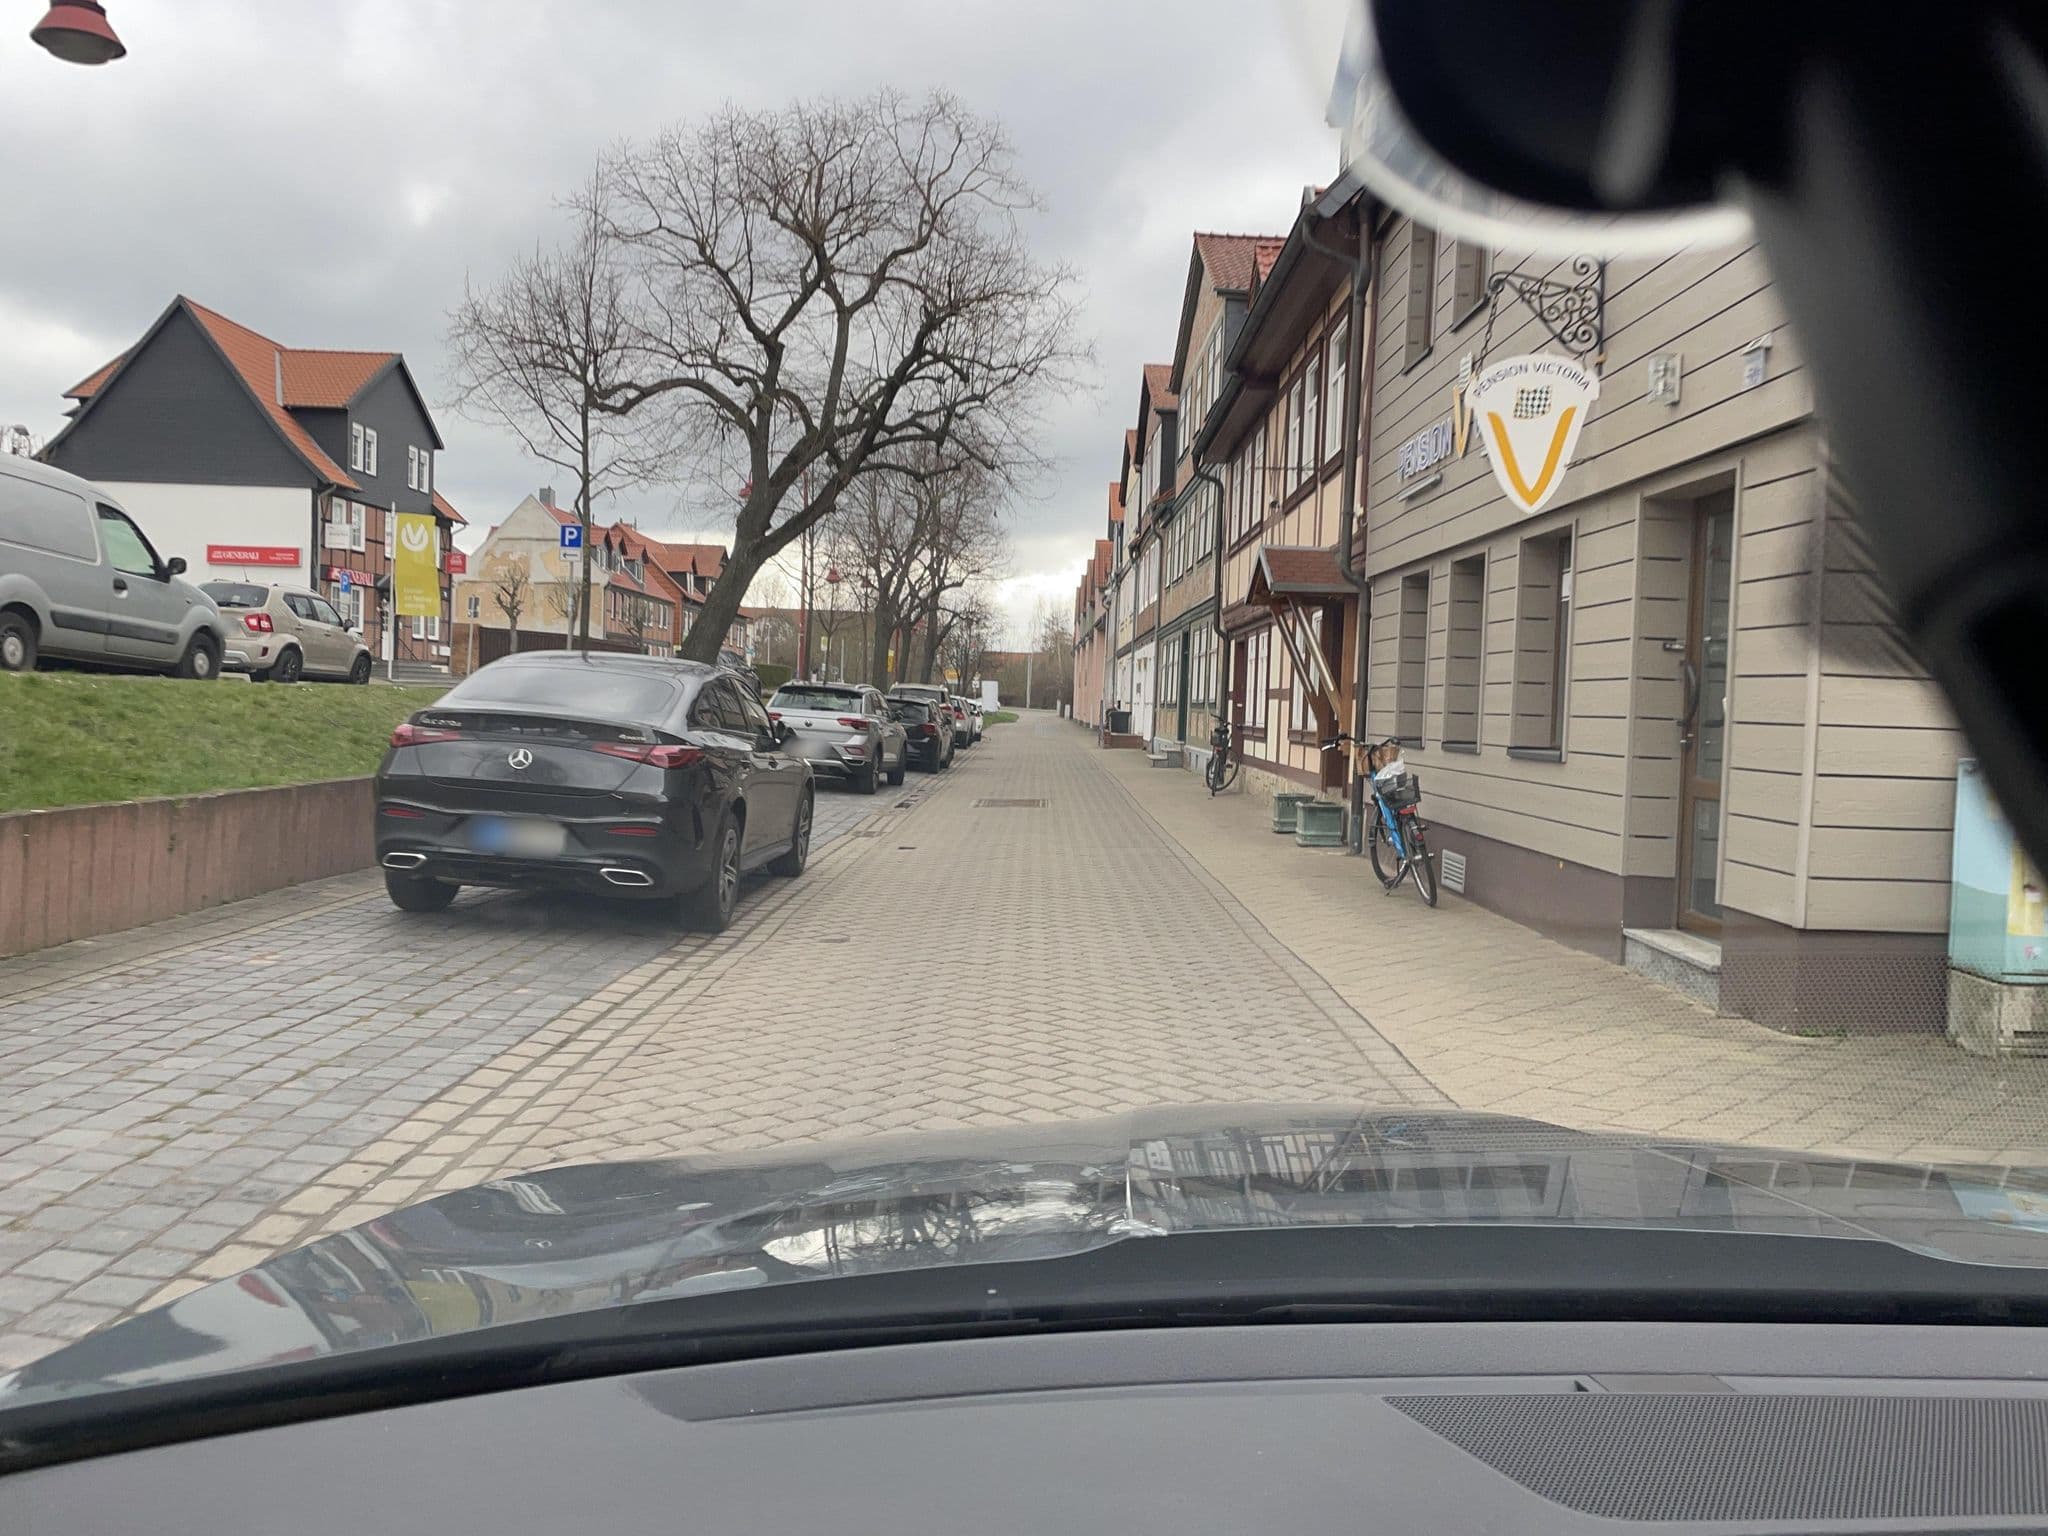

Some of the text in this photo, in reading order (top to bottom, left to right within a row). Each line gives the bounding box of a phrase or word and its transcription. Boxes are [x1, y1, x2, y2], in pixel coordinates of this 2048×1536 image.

[1473, 362, 1591, 398] PENSION VICTORIA
[1397, 416, 1453, 482] PENSION
[565, 527, 578, 546] P
[223, 551, 260, 560] GENERALI
